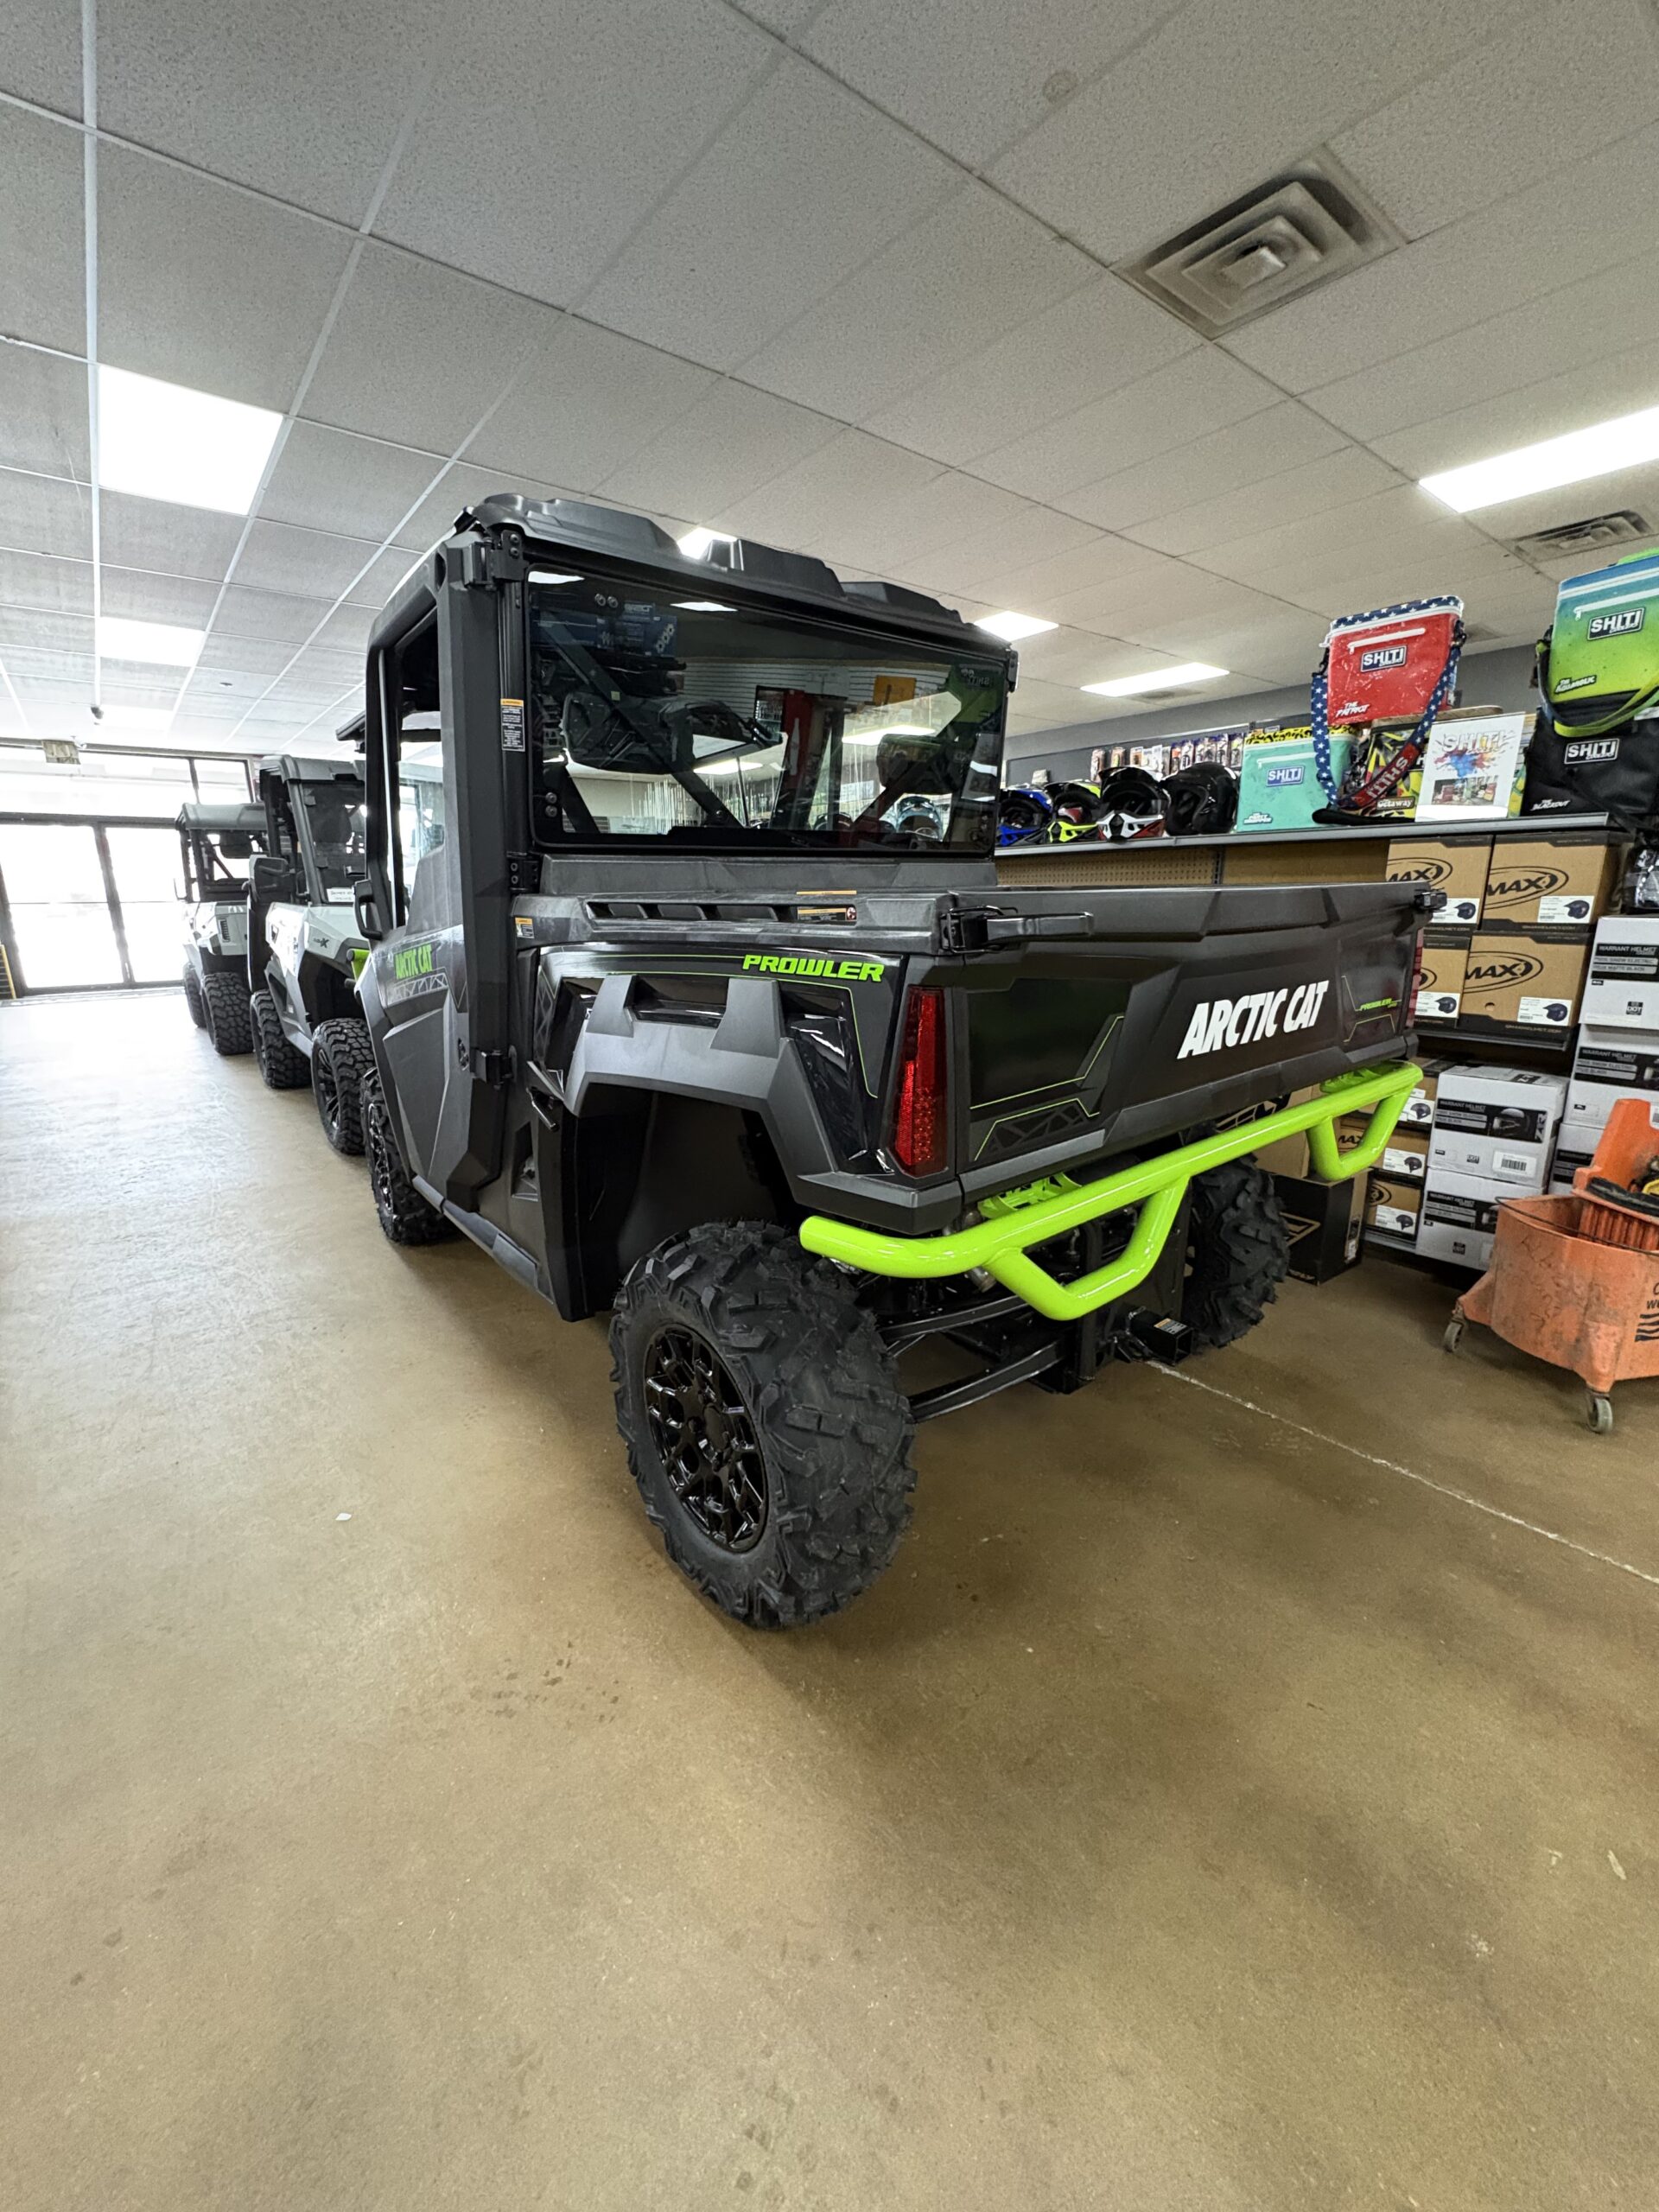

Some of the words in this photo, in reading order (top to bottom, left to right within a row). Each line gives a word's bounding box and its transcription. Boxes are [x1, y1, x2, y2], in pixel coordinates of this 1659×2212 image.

[1336, 704, 1370, 717] PATRIOT
[1568, 741, 1616, 758] SHITI
[396, 948, 418, 980] ARCTIC
[418, 944, 432, 974] CAT
[742, 954, 885, 982] PROWLER
[1176, 987, 1287, 1060] ARCTIC
[1282, 980, 1329, 1033] CAT
